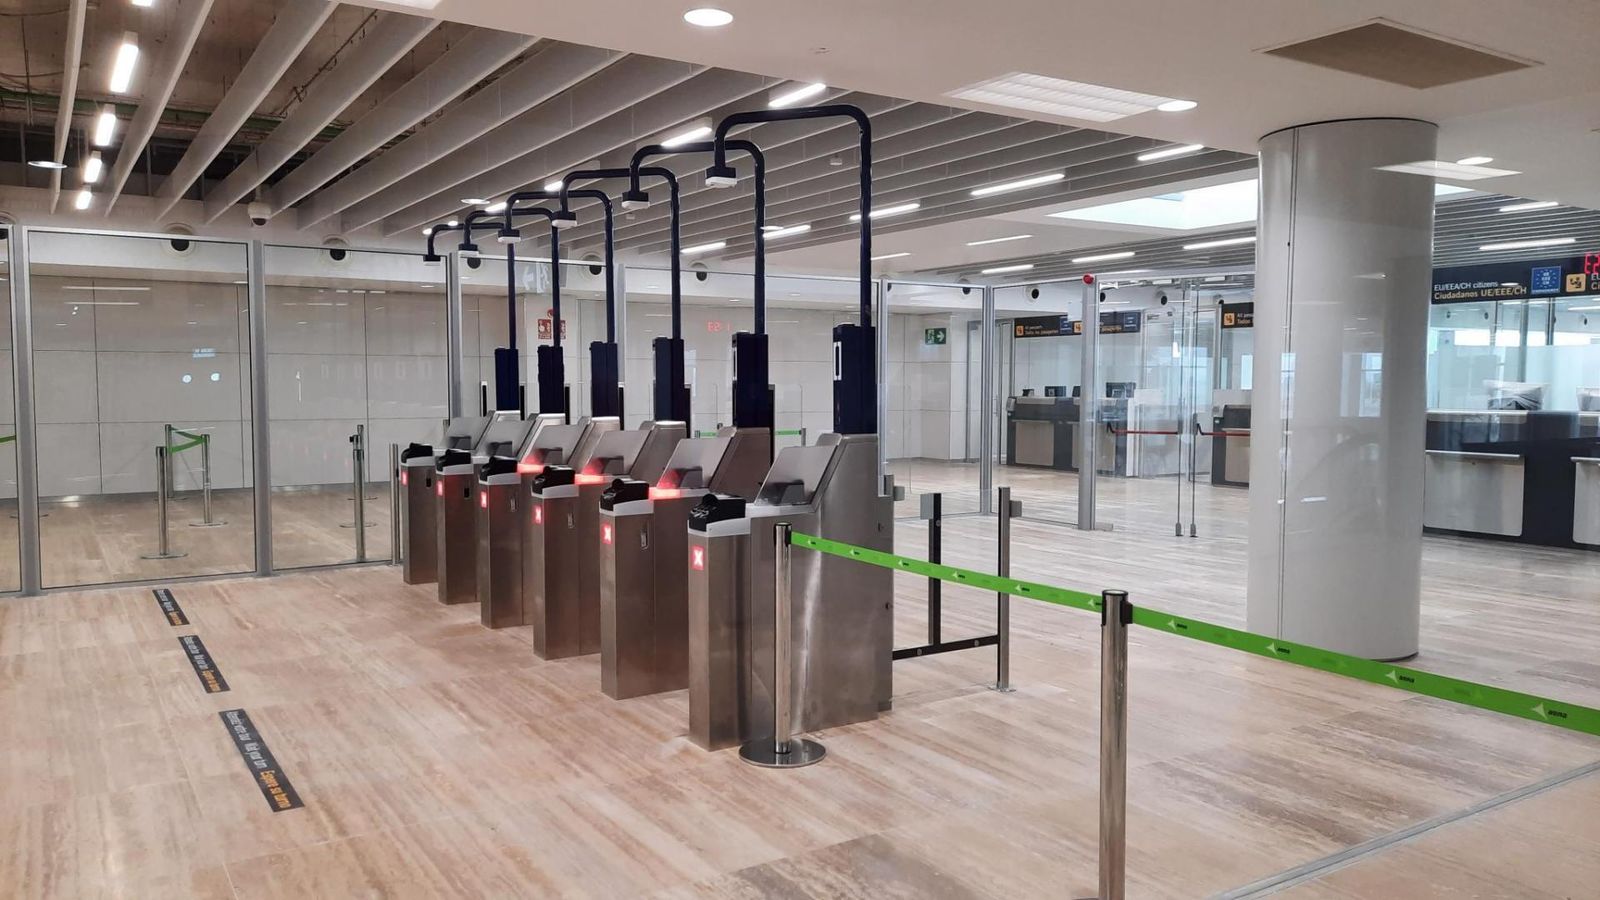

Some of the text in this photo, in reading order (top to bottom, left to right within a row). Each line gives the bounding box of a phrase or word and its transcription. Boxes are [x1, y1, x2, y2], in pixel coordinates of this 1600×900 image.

[1434, 281, 1498, 292] EU/EEA/CH citizens
[1434, 290, 1478, 300] Ciudadanos
[1480, 286, 1527, 297] UE/EEE/CH
